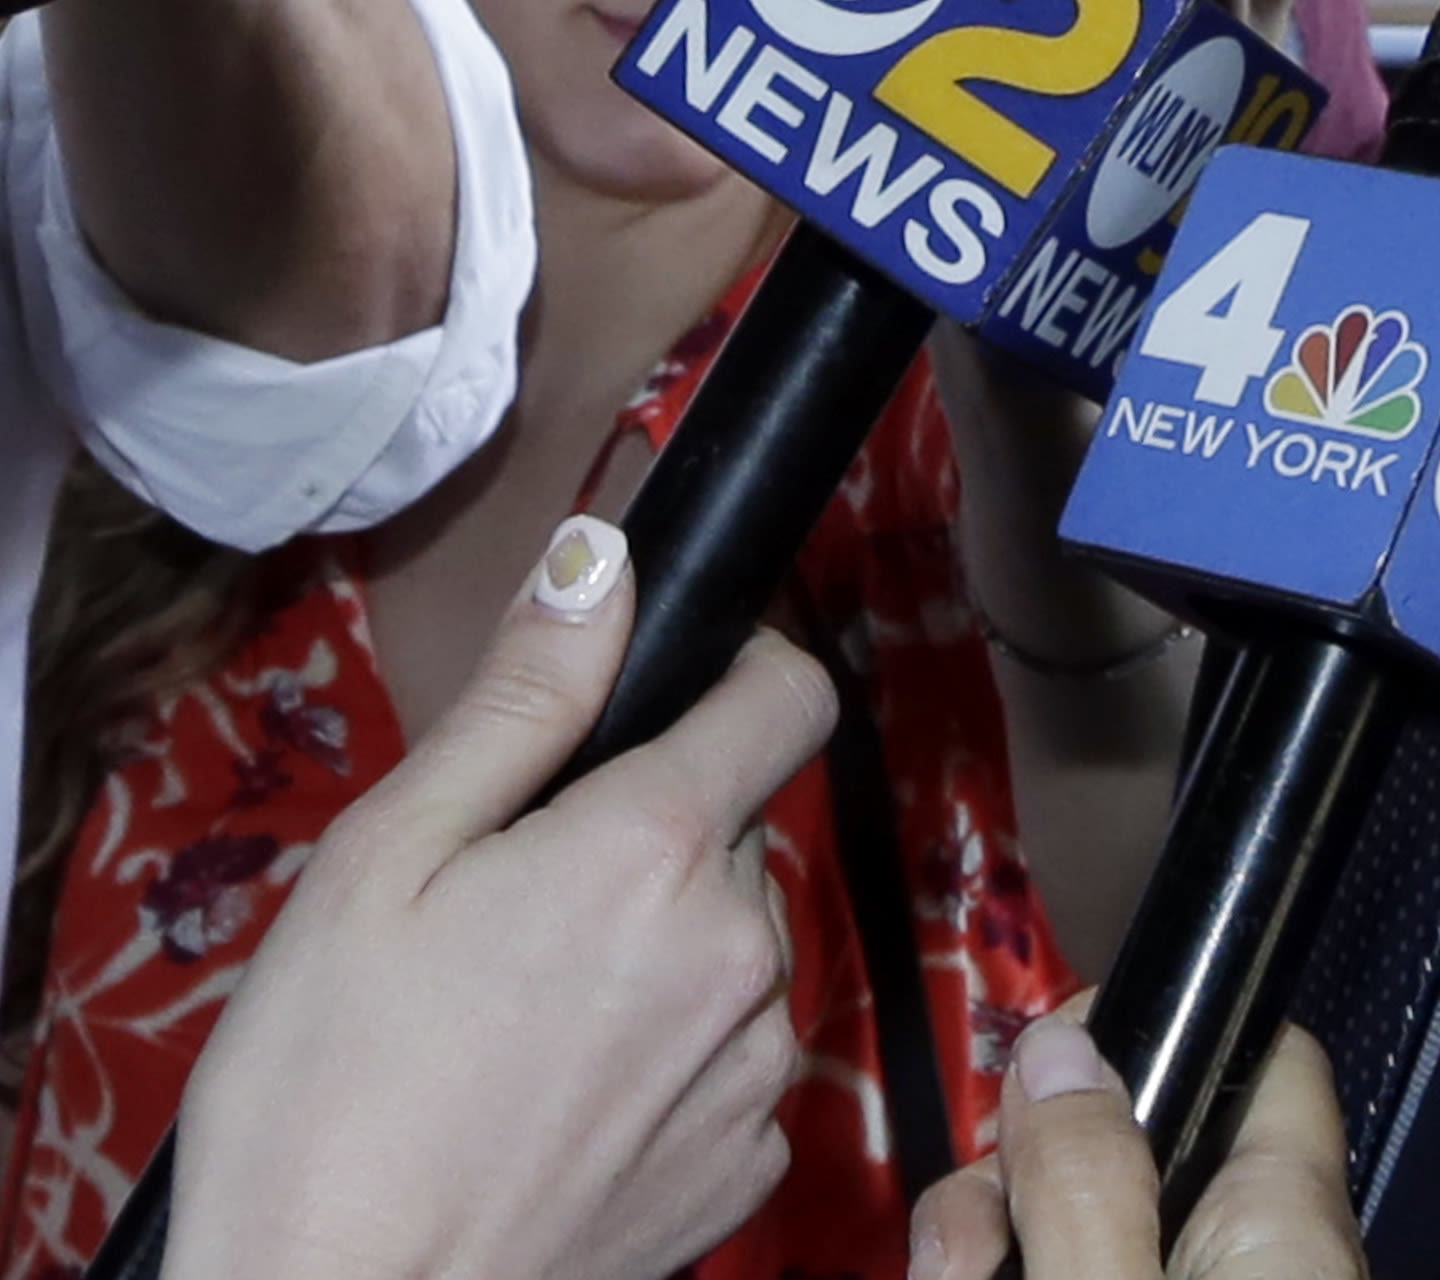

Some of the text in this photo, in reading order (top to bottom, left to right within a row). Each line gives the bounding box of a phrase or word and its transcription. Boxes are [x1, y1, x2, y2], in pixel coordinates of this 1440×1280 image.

[998, 237, 1150, 378] NEW
[1140, 212, 1310, 407] 4
[1107, 395, 1399, 496] NEW YORK
